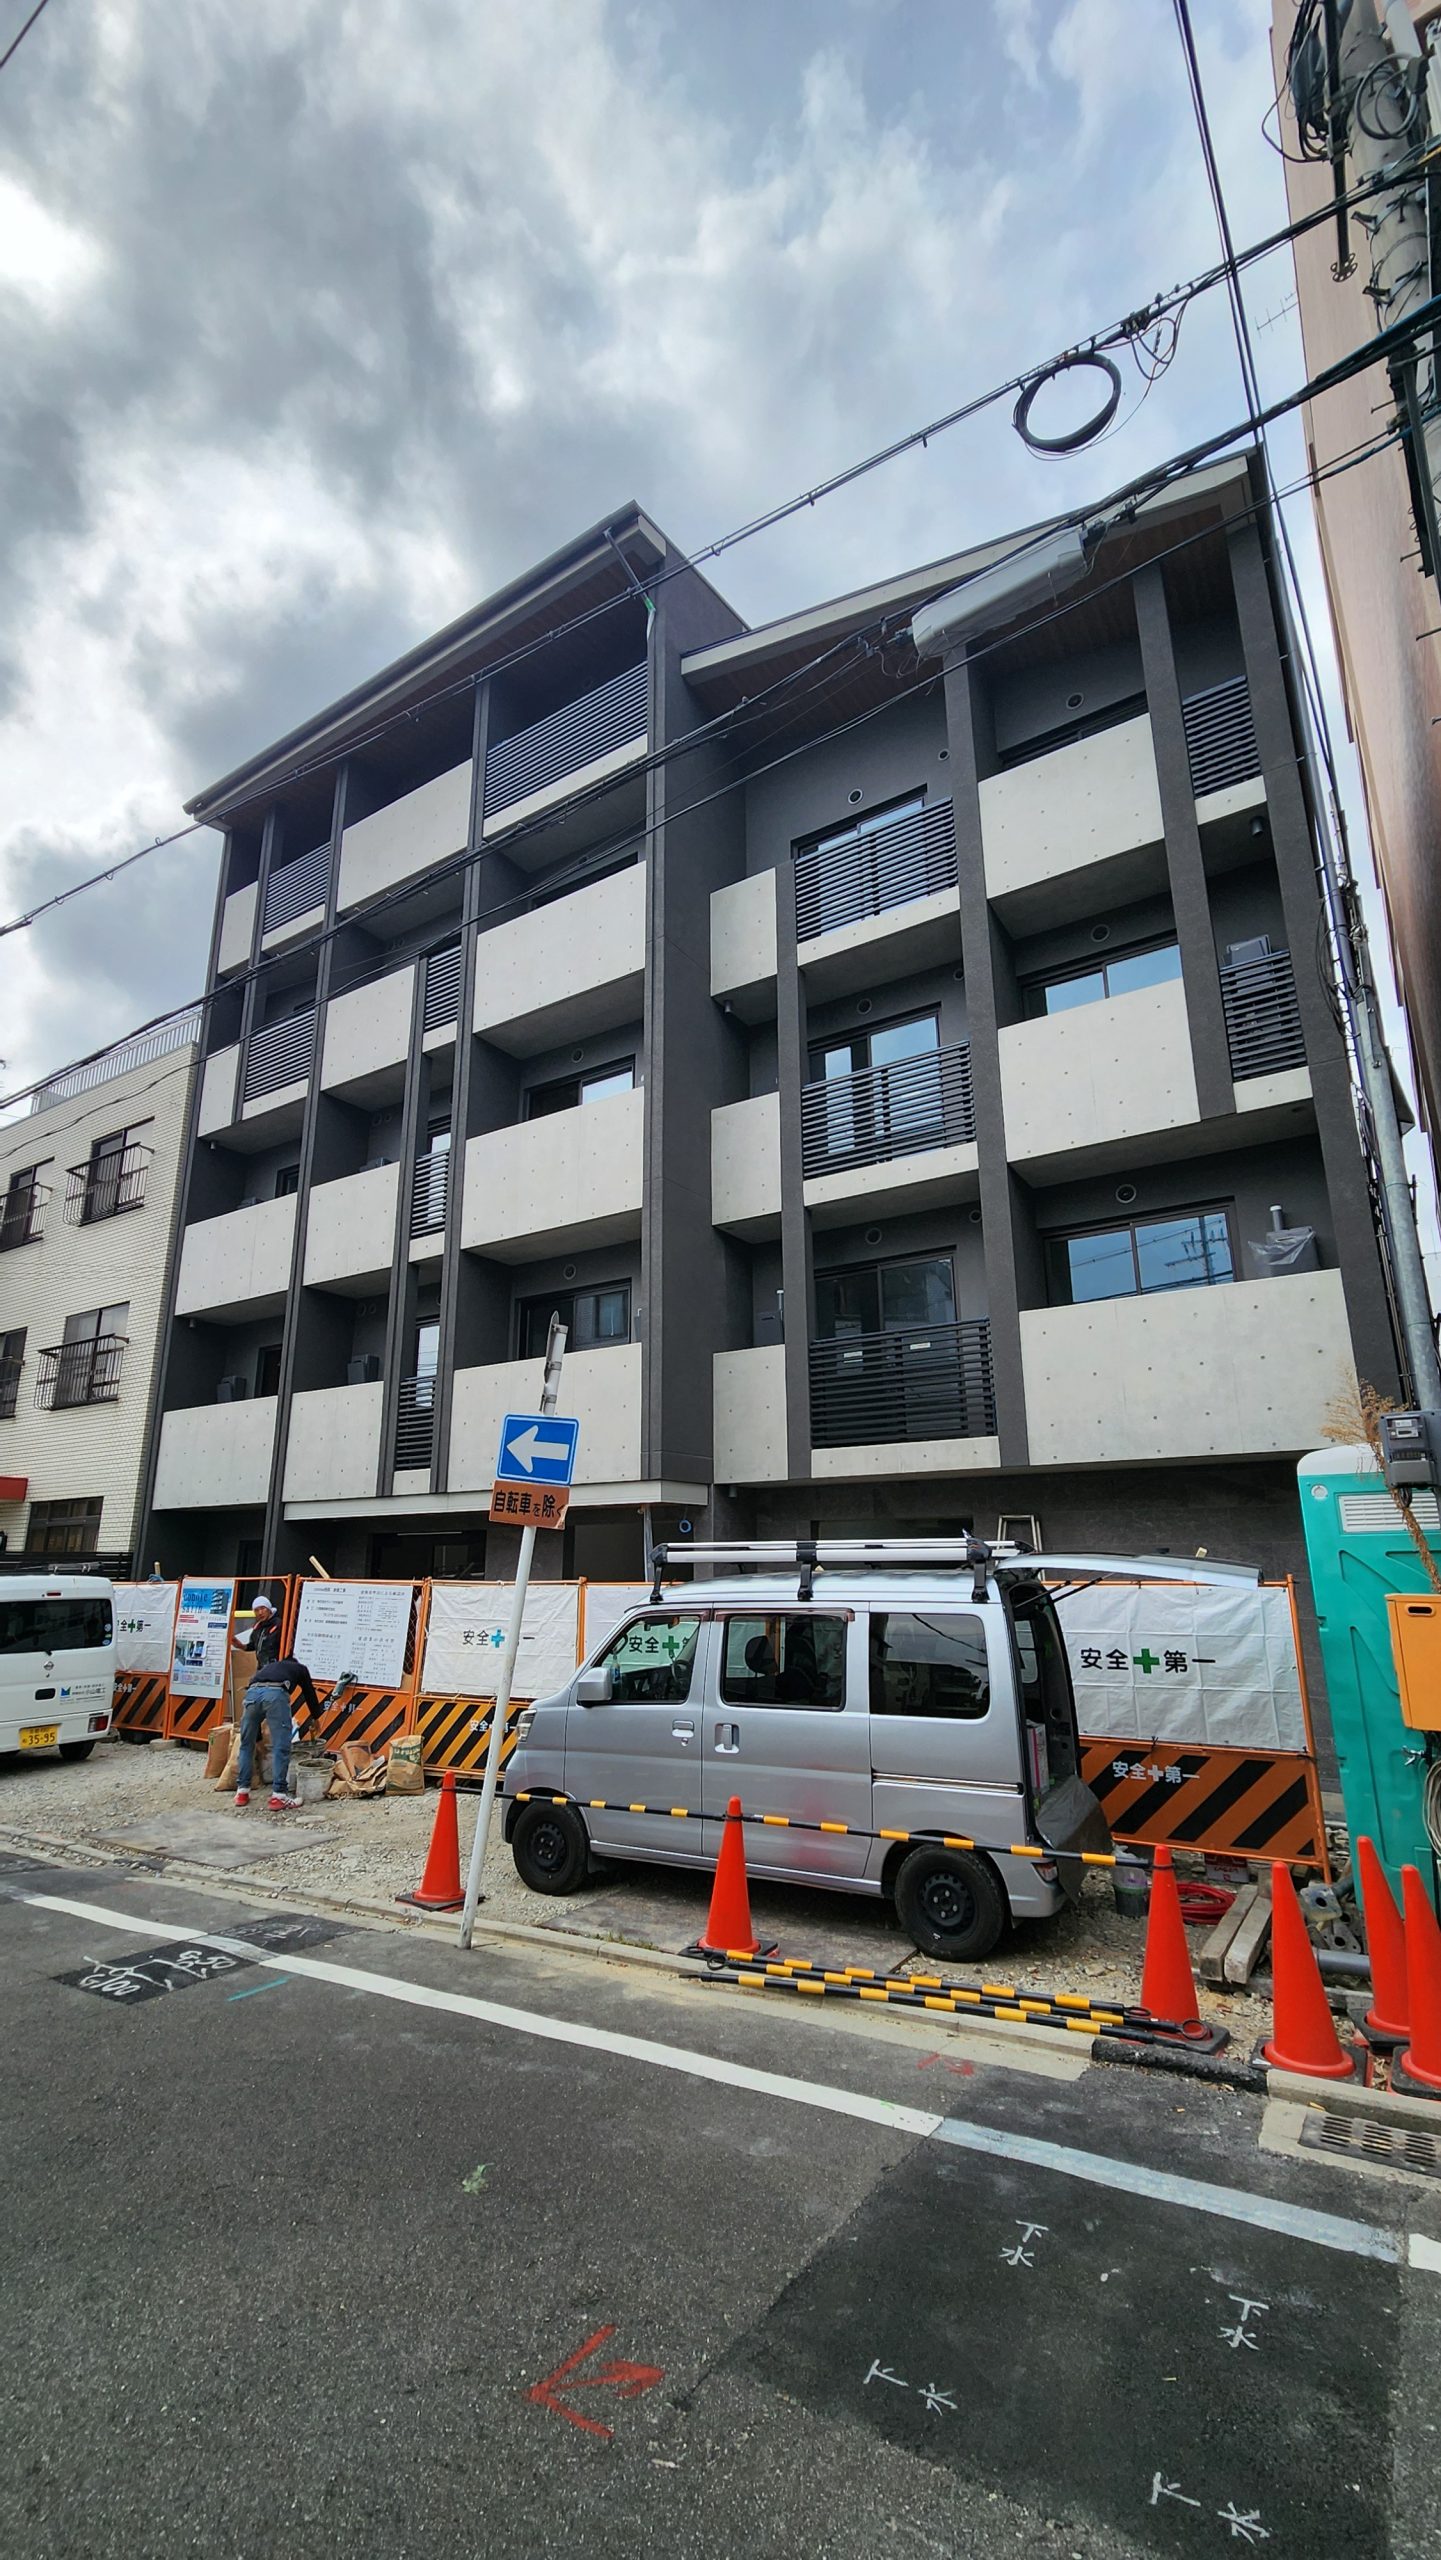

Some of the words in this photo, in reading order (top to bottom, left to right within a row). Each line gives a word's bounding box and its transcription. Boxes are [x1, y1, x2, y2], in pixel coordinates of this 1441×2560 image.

[494, 1490, 565, 1518] 自転車を除く
[462, 1629, 489, 1646] 安全
[629, 1635, 659, 1654] 安全
